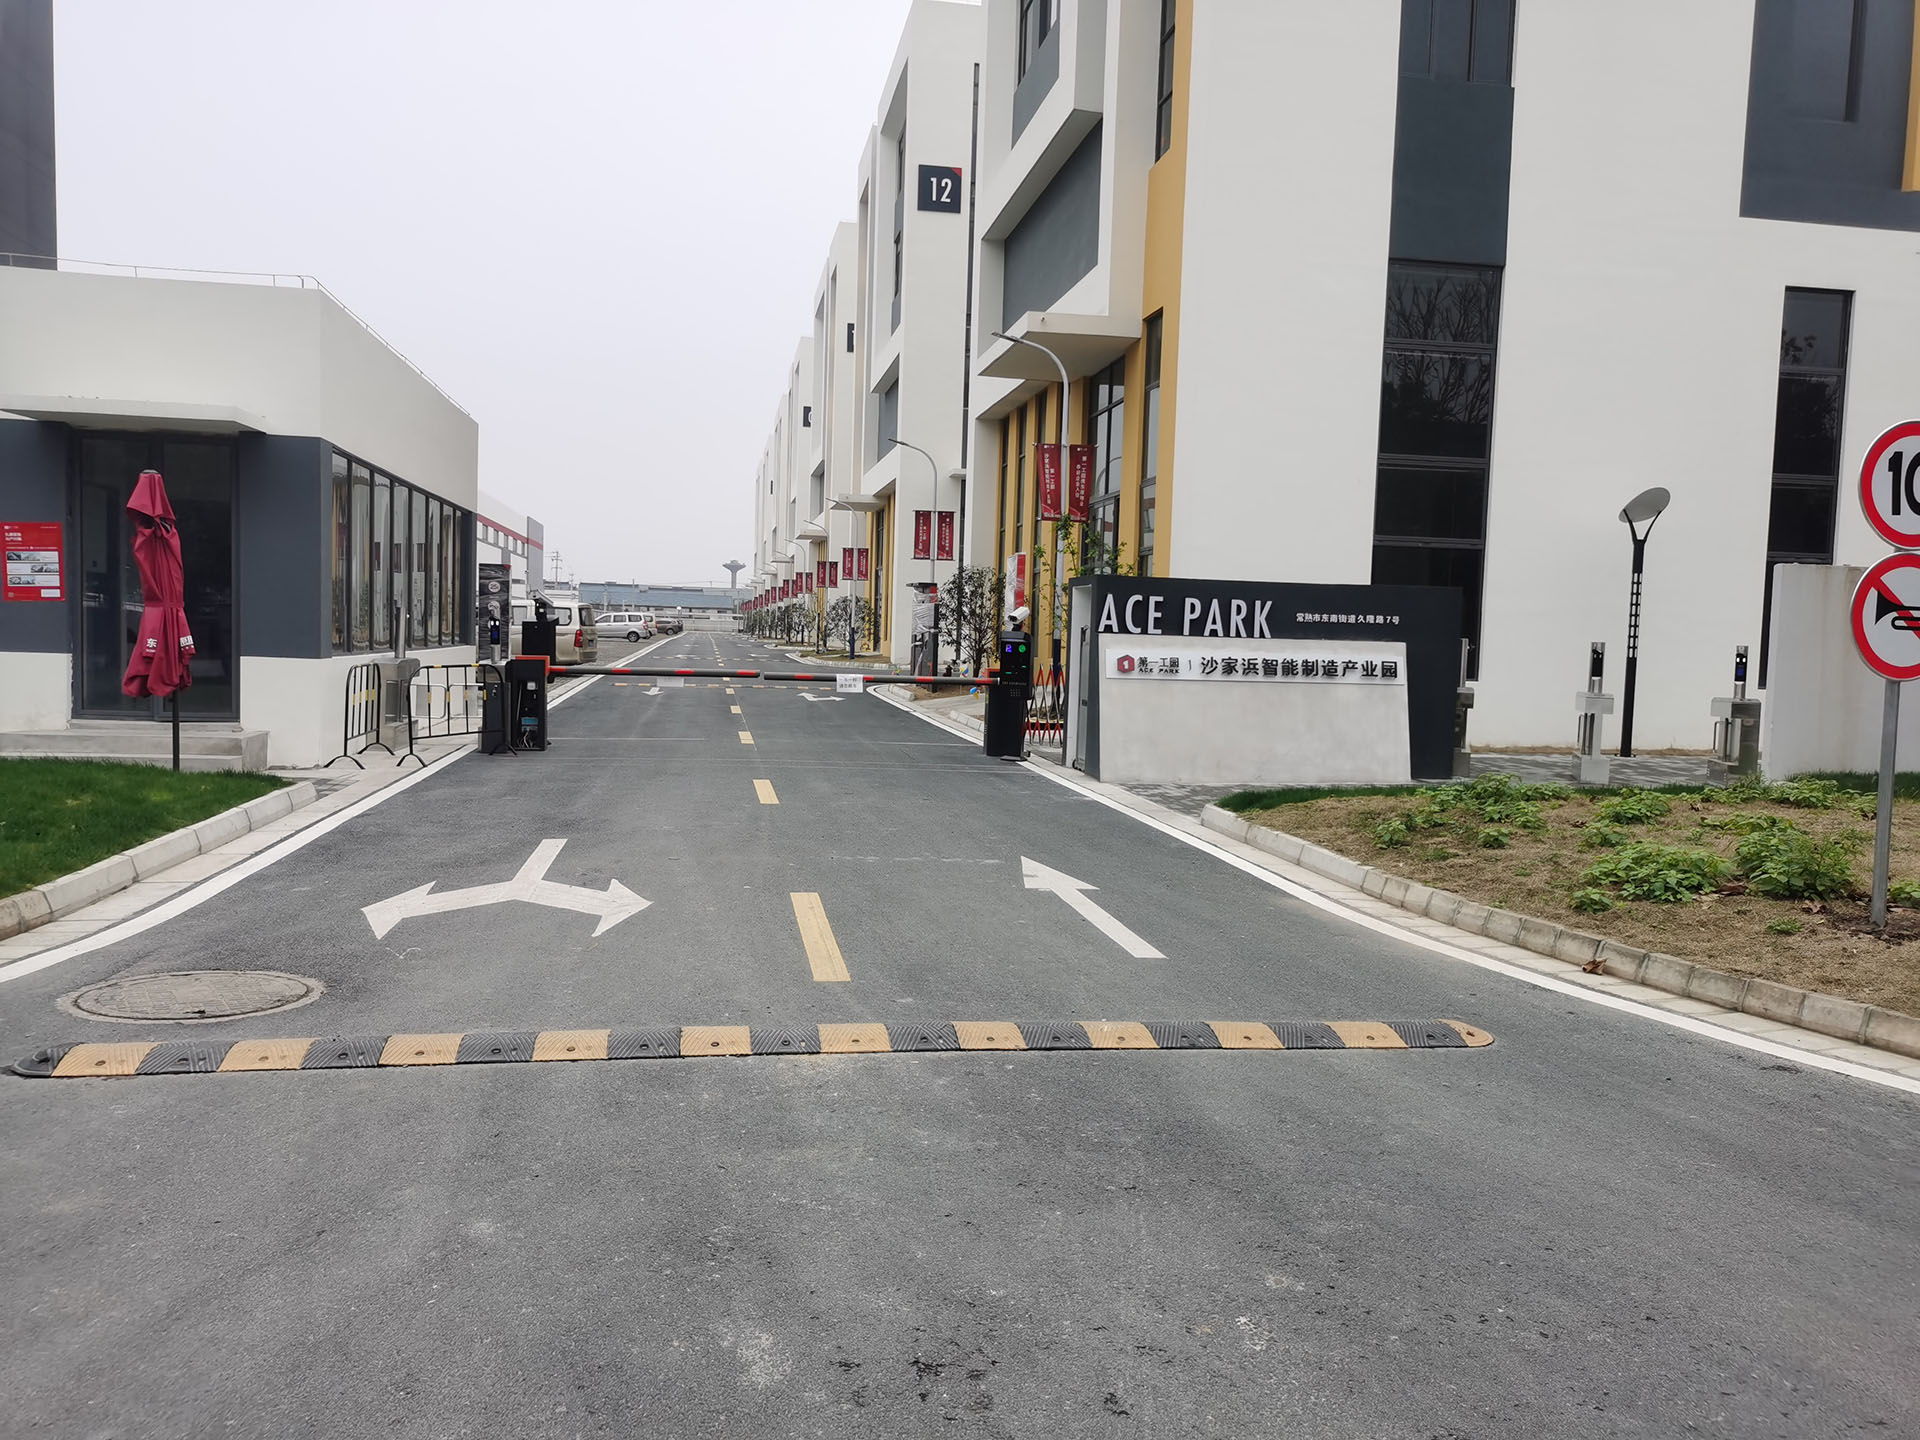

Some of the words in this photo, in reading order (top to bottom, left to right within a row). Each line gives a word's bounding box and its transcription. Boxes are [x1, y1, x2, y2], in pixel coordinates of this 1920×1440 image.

[930, 177, 952, 202] 12
[1098, 593, 1164, 634] ACE
[1183, 597, 1273, 639] PARK
[146, 637, 158, 648] 东
[1137, 656, 1180, 668] 第一工园
[1200, 656, 1398, 679] 沙家浜智能制造产业园
